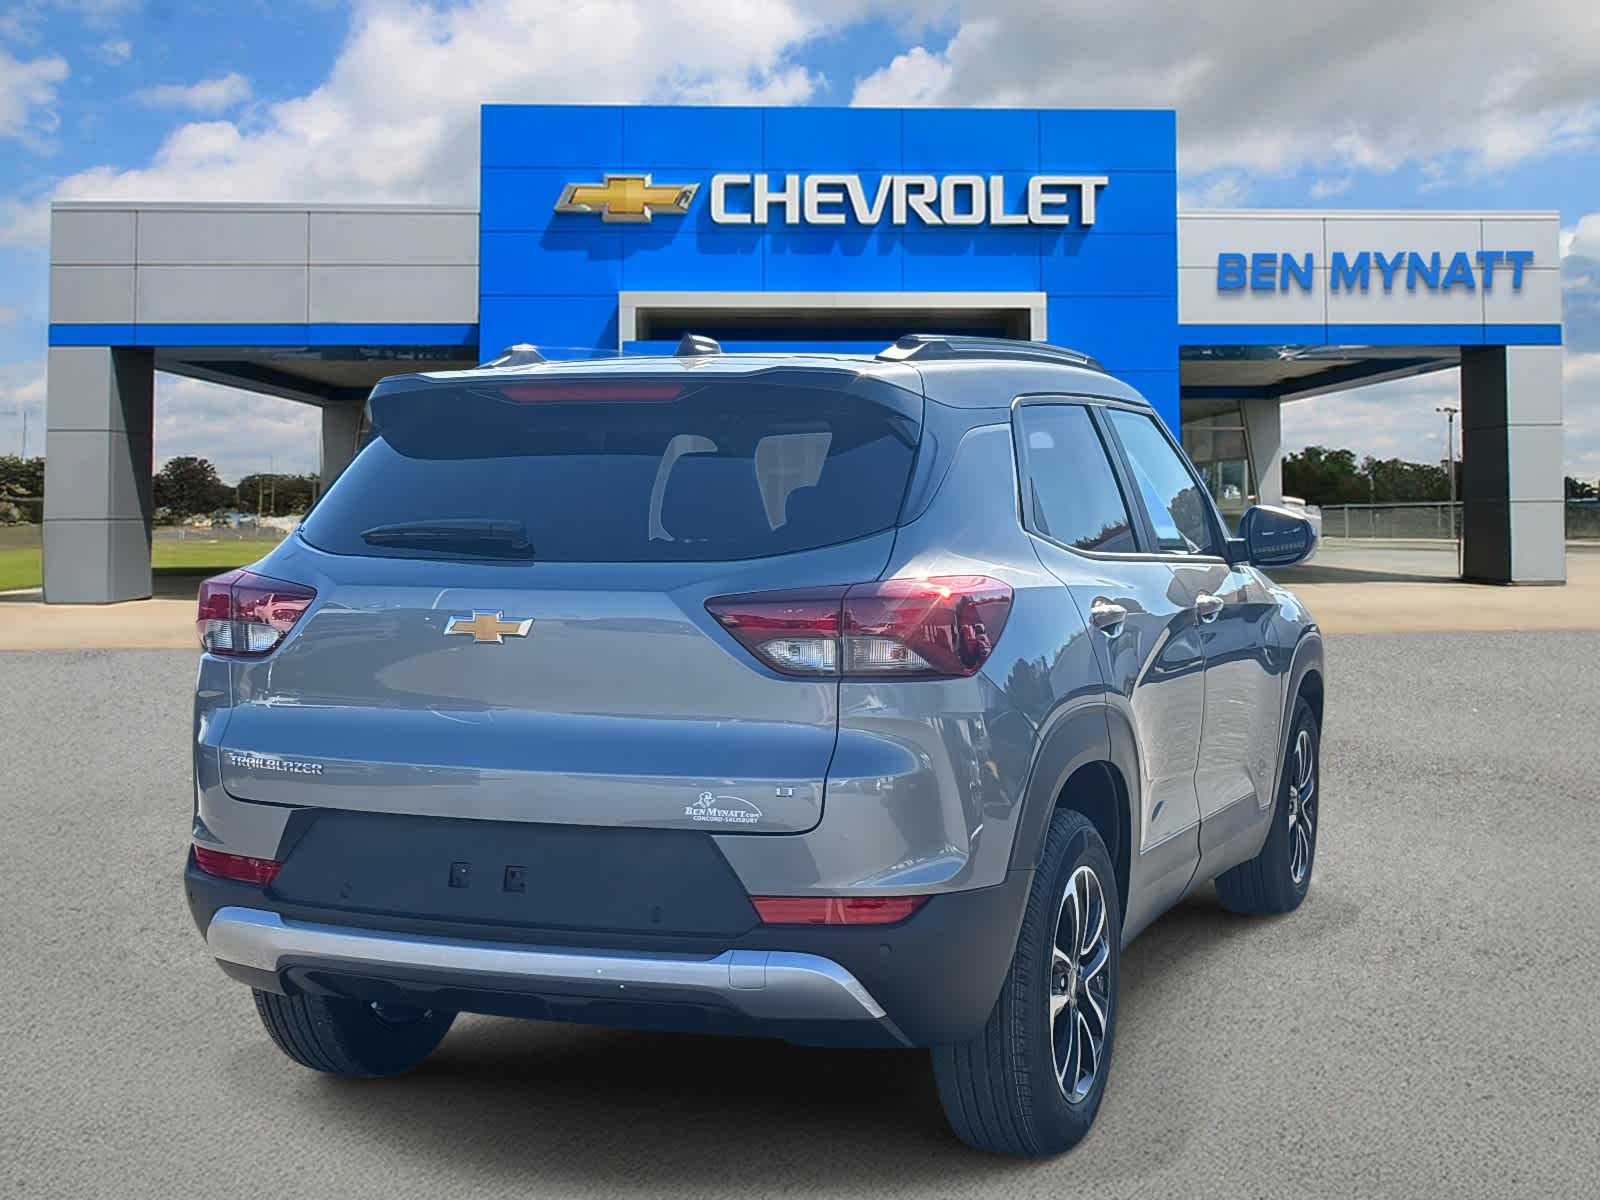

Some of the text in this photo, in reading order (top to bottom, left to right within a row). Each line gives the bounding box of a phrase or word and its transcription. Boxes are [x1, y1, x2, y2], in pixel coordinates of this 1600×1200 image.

[710, 174, 1109, 225] CHEVROLET
[1217, 251, 1534, 291] BEN MYNATT
[229, 753, 323, 775] TRAILBLAZER
